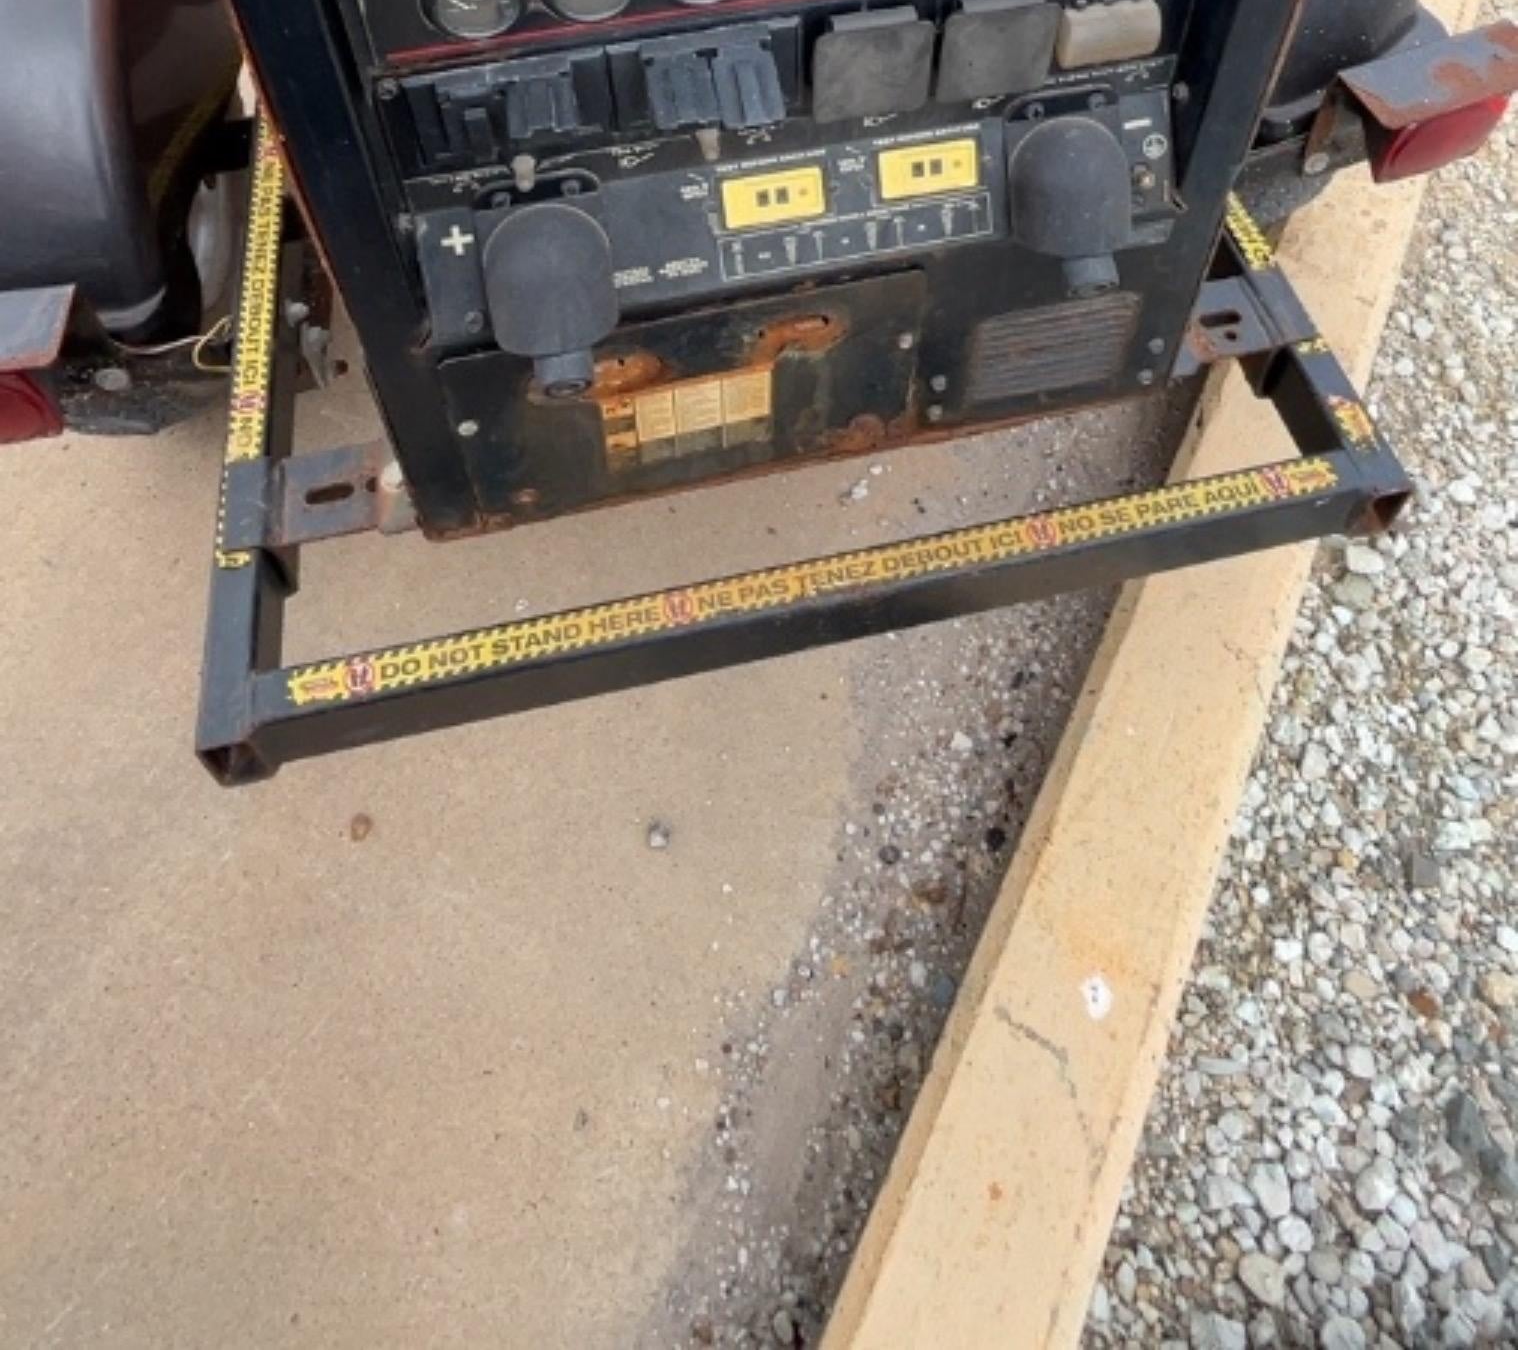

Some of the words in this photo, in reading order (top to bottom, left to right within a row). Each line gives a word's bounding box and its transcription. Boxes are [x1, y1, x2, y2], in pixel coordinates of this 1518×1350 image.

[379, 659, 421, 679] DO
[428, 645, 486, 668] NOT
[491, 622, 583, 655] STAND
[587, 606, 661, 633] HERE
[698, 591, 733, 613] NE
[738, 577, 790, 600] PAS
[789, 559, 876, 589] TENEZ
[881, 538, 984, 572] DEBOUT
[989, 532, 1023, 550] ICI
[1058, 515, 1093, 534] NO
[1100, 507, 1131, 524] SE
[1134, 494, 1200, 518] PARE
[1204, 481, 1261, 503] AQUI
